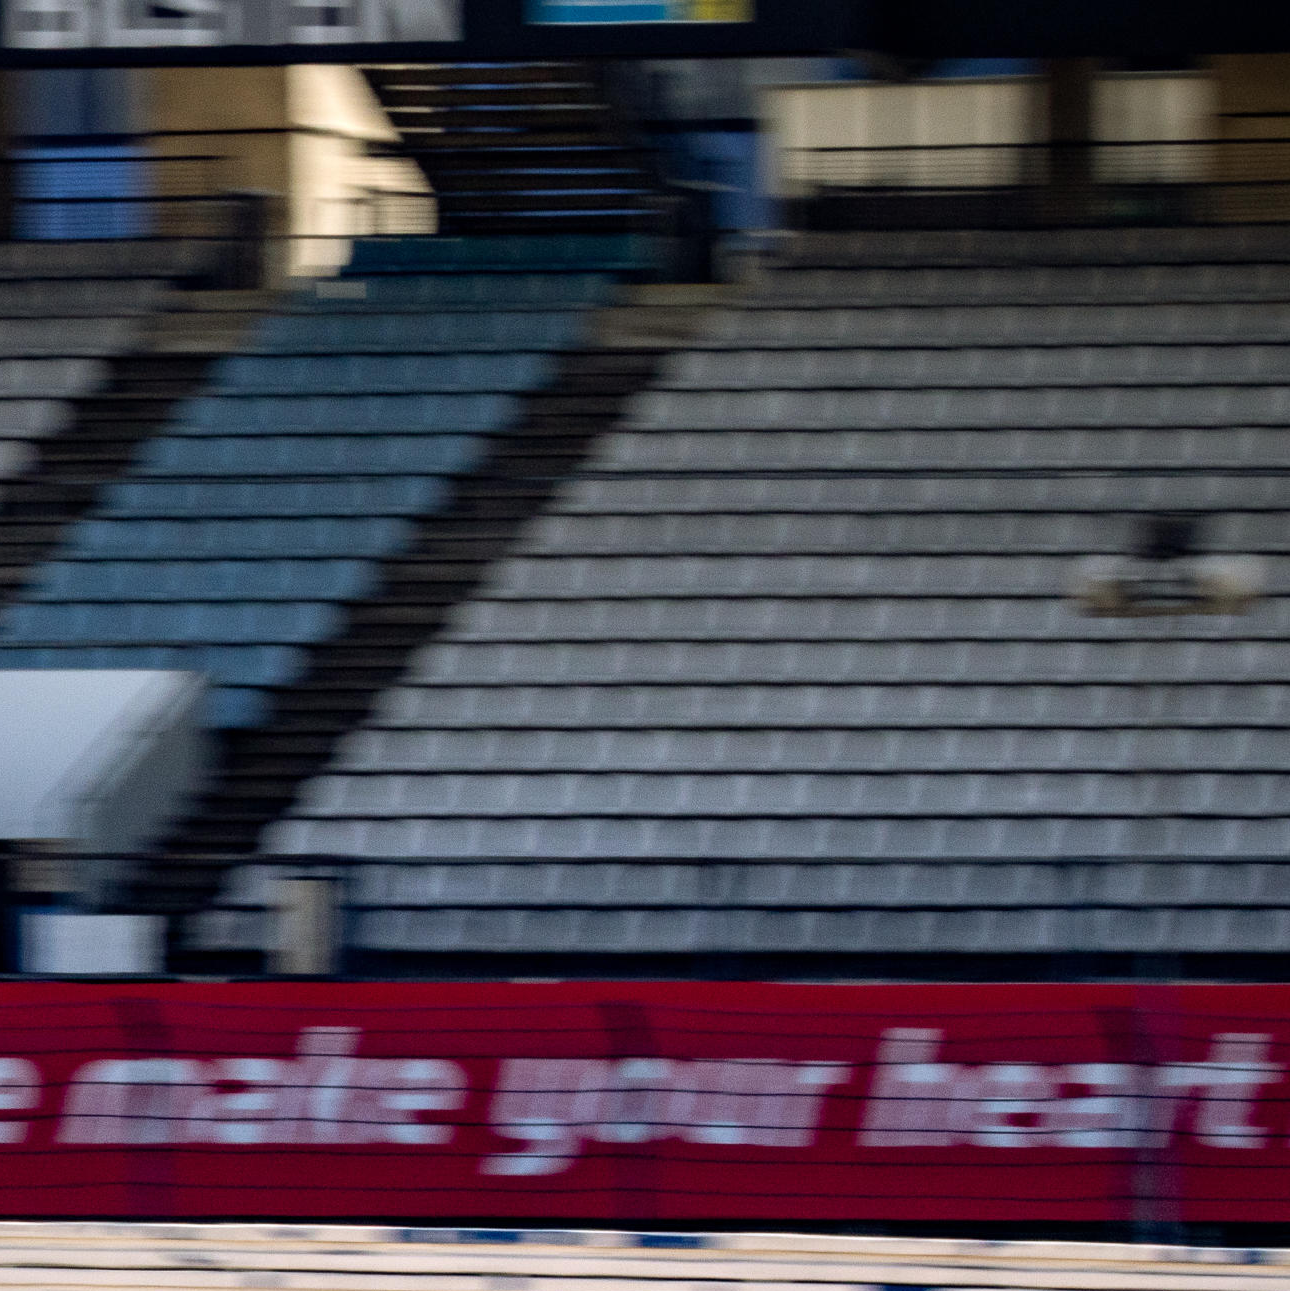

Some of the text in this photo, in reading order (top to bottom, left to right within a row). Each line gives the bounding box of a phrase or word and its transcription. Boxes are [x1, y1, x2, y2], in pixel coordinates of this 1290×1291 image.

[53, 1027, 469, 1143] make
[479, 1057, 851, 1175] your
[857, 1028, 1285, 1148] heart
